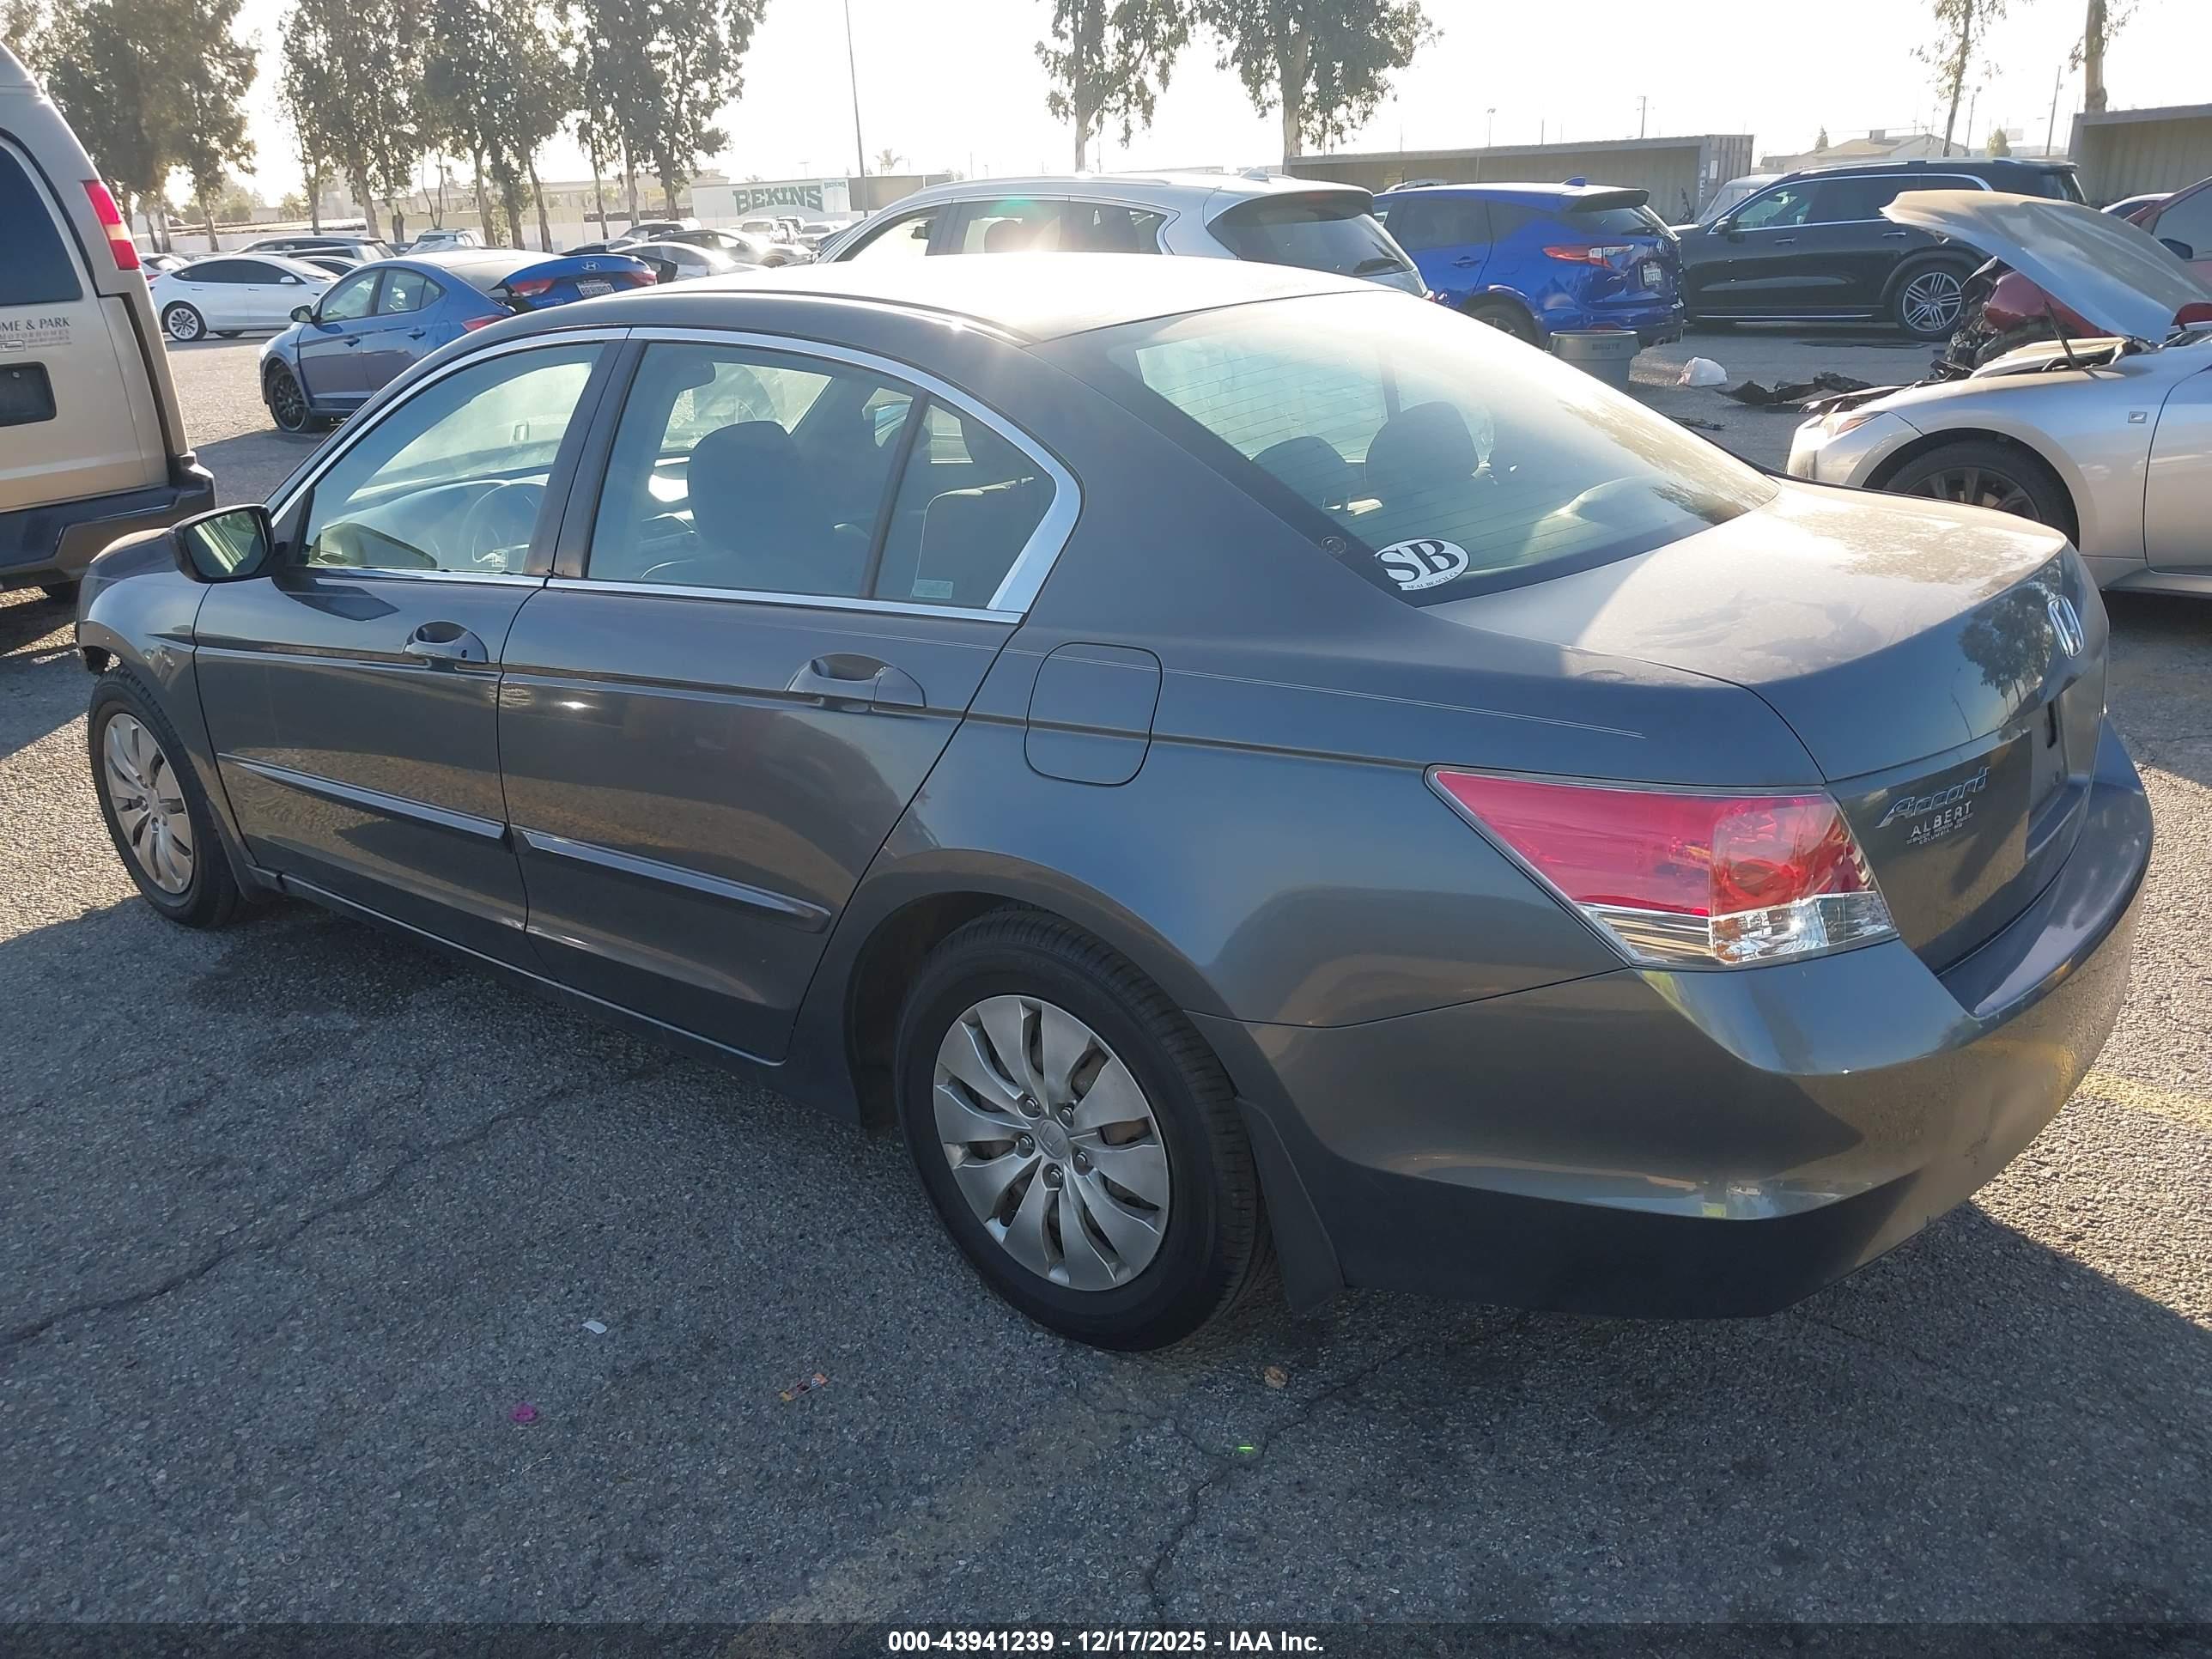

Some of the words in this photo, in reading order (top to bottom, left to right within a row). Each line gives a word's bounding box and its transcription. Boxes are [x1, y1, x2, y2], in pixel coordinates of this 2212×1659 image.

[732, 185, 824, 216] BEKINS
[0, 320, 21, 331] ME
[26, 319, 35, 331] &
[40, 317, 70, 330] PARK
[1376, 540, 1460, 583] SB
[1875, 766, 1991, 829] Accord
[1910, 800, 1972, 838] ALBERT
